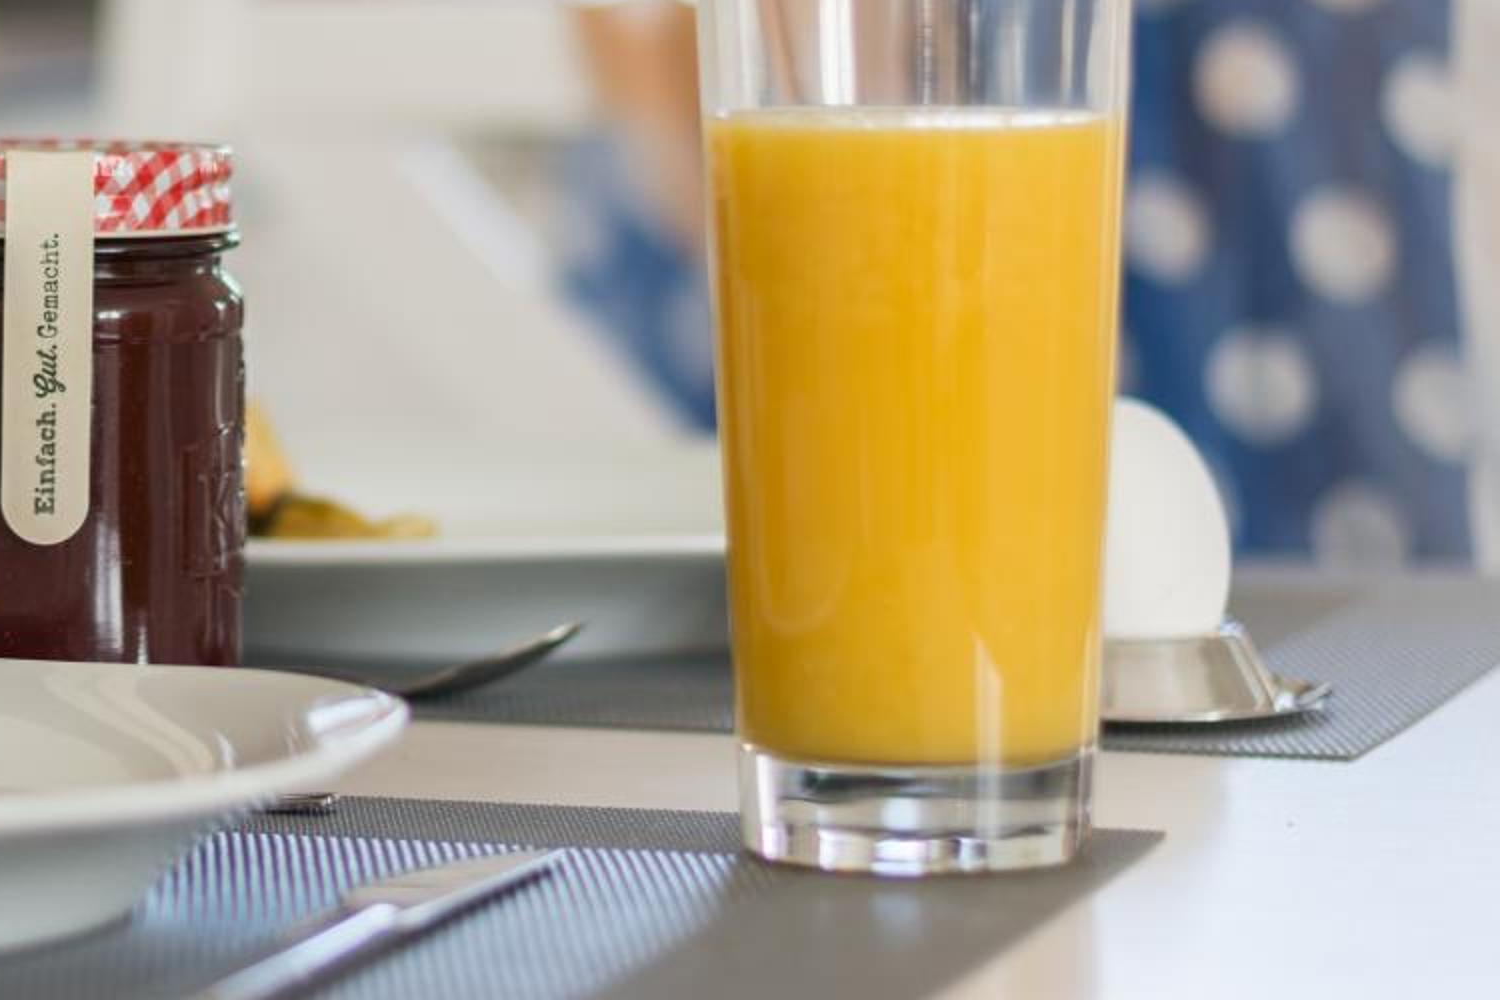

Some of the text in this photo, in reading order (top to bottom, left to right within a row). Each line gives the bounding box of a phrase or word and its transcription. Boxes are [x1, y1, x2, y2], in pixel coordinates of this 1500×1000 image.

[33, 232, 67, 516] Einfach. Gut. Gemacht.
